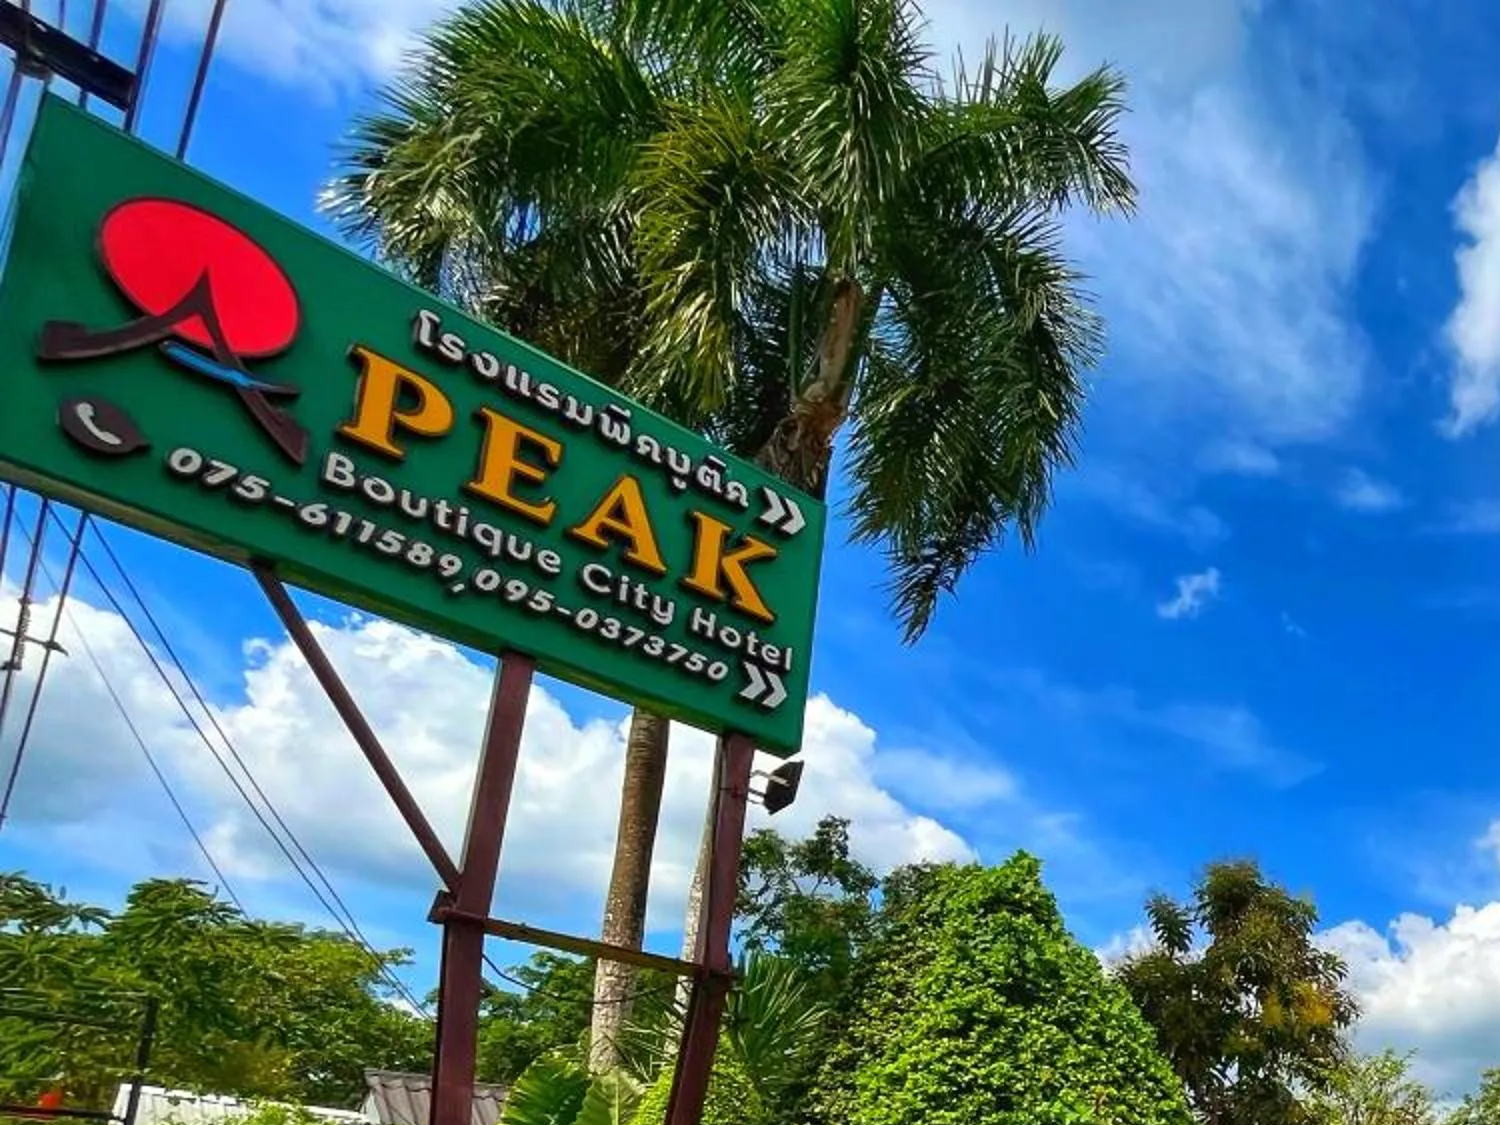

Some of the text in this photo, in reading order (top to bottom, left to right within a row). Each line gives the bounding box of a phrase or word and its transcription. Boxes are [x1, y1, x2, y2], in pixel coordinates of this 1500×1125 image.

[324, 450, 793, 672] Boutique City Hotel
[340, 344, 777, 623] PEAK
